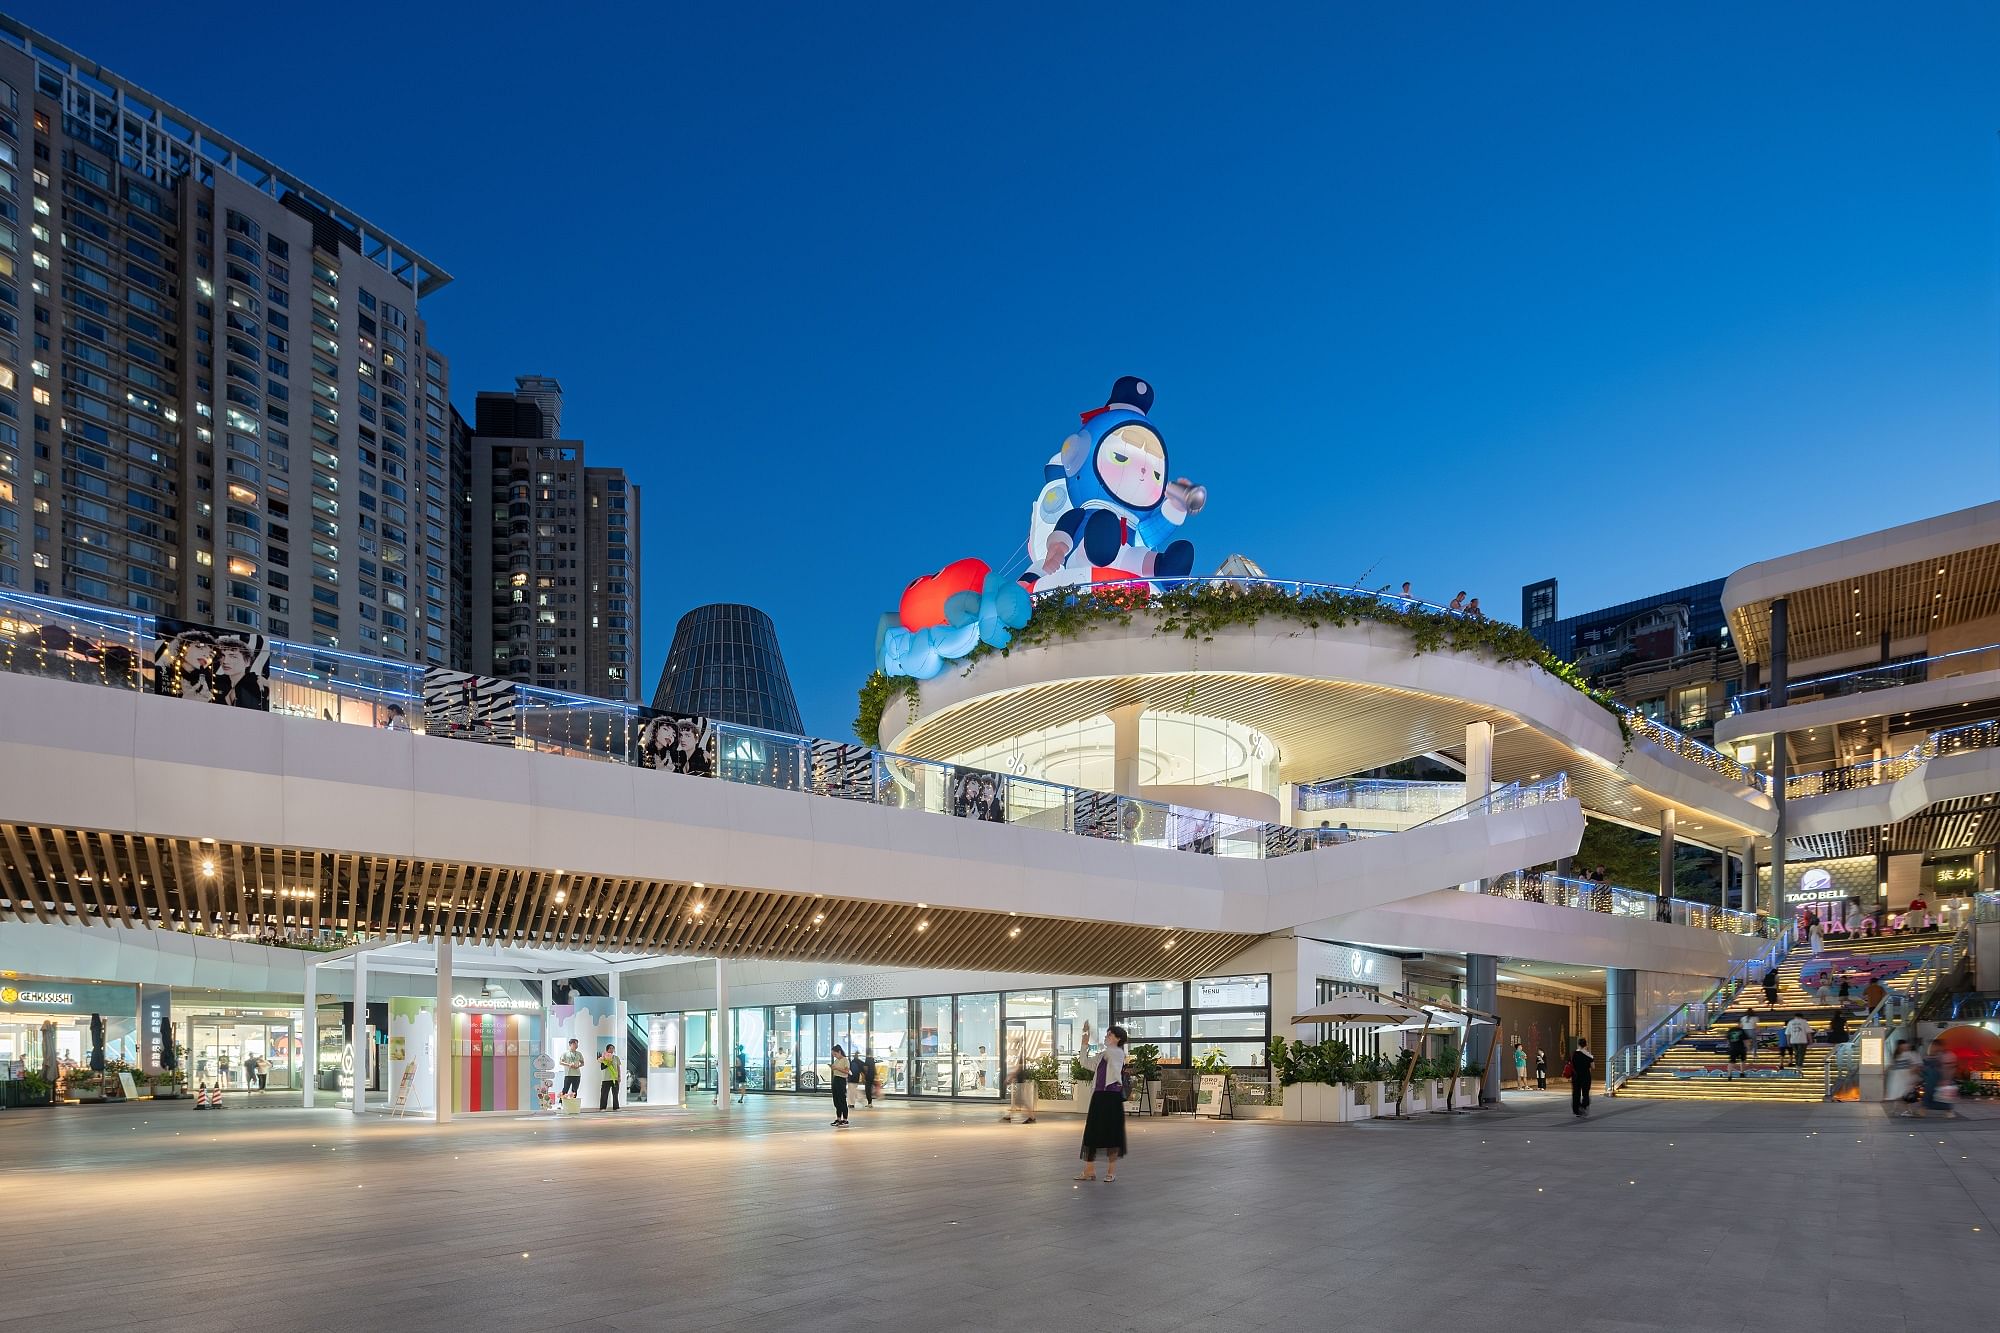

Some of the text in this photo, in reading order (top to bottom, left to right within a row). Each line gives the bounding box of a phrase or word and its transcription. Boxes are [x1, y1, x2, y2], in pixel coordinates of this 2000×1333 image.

[1786, 890, 1848, 902] TACO BELL
[468, 998, 512, 1009] Purcotton
